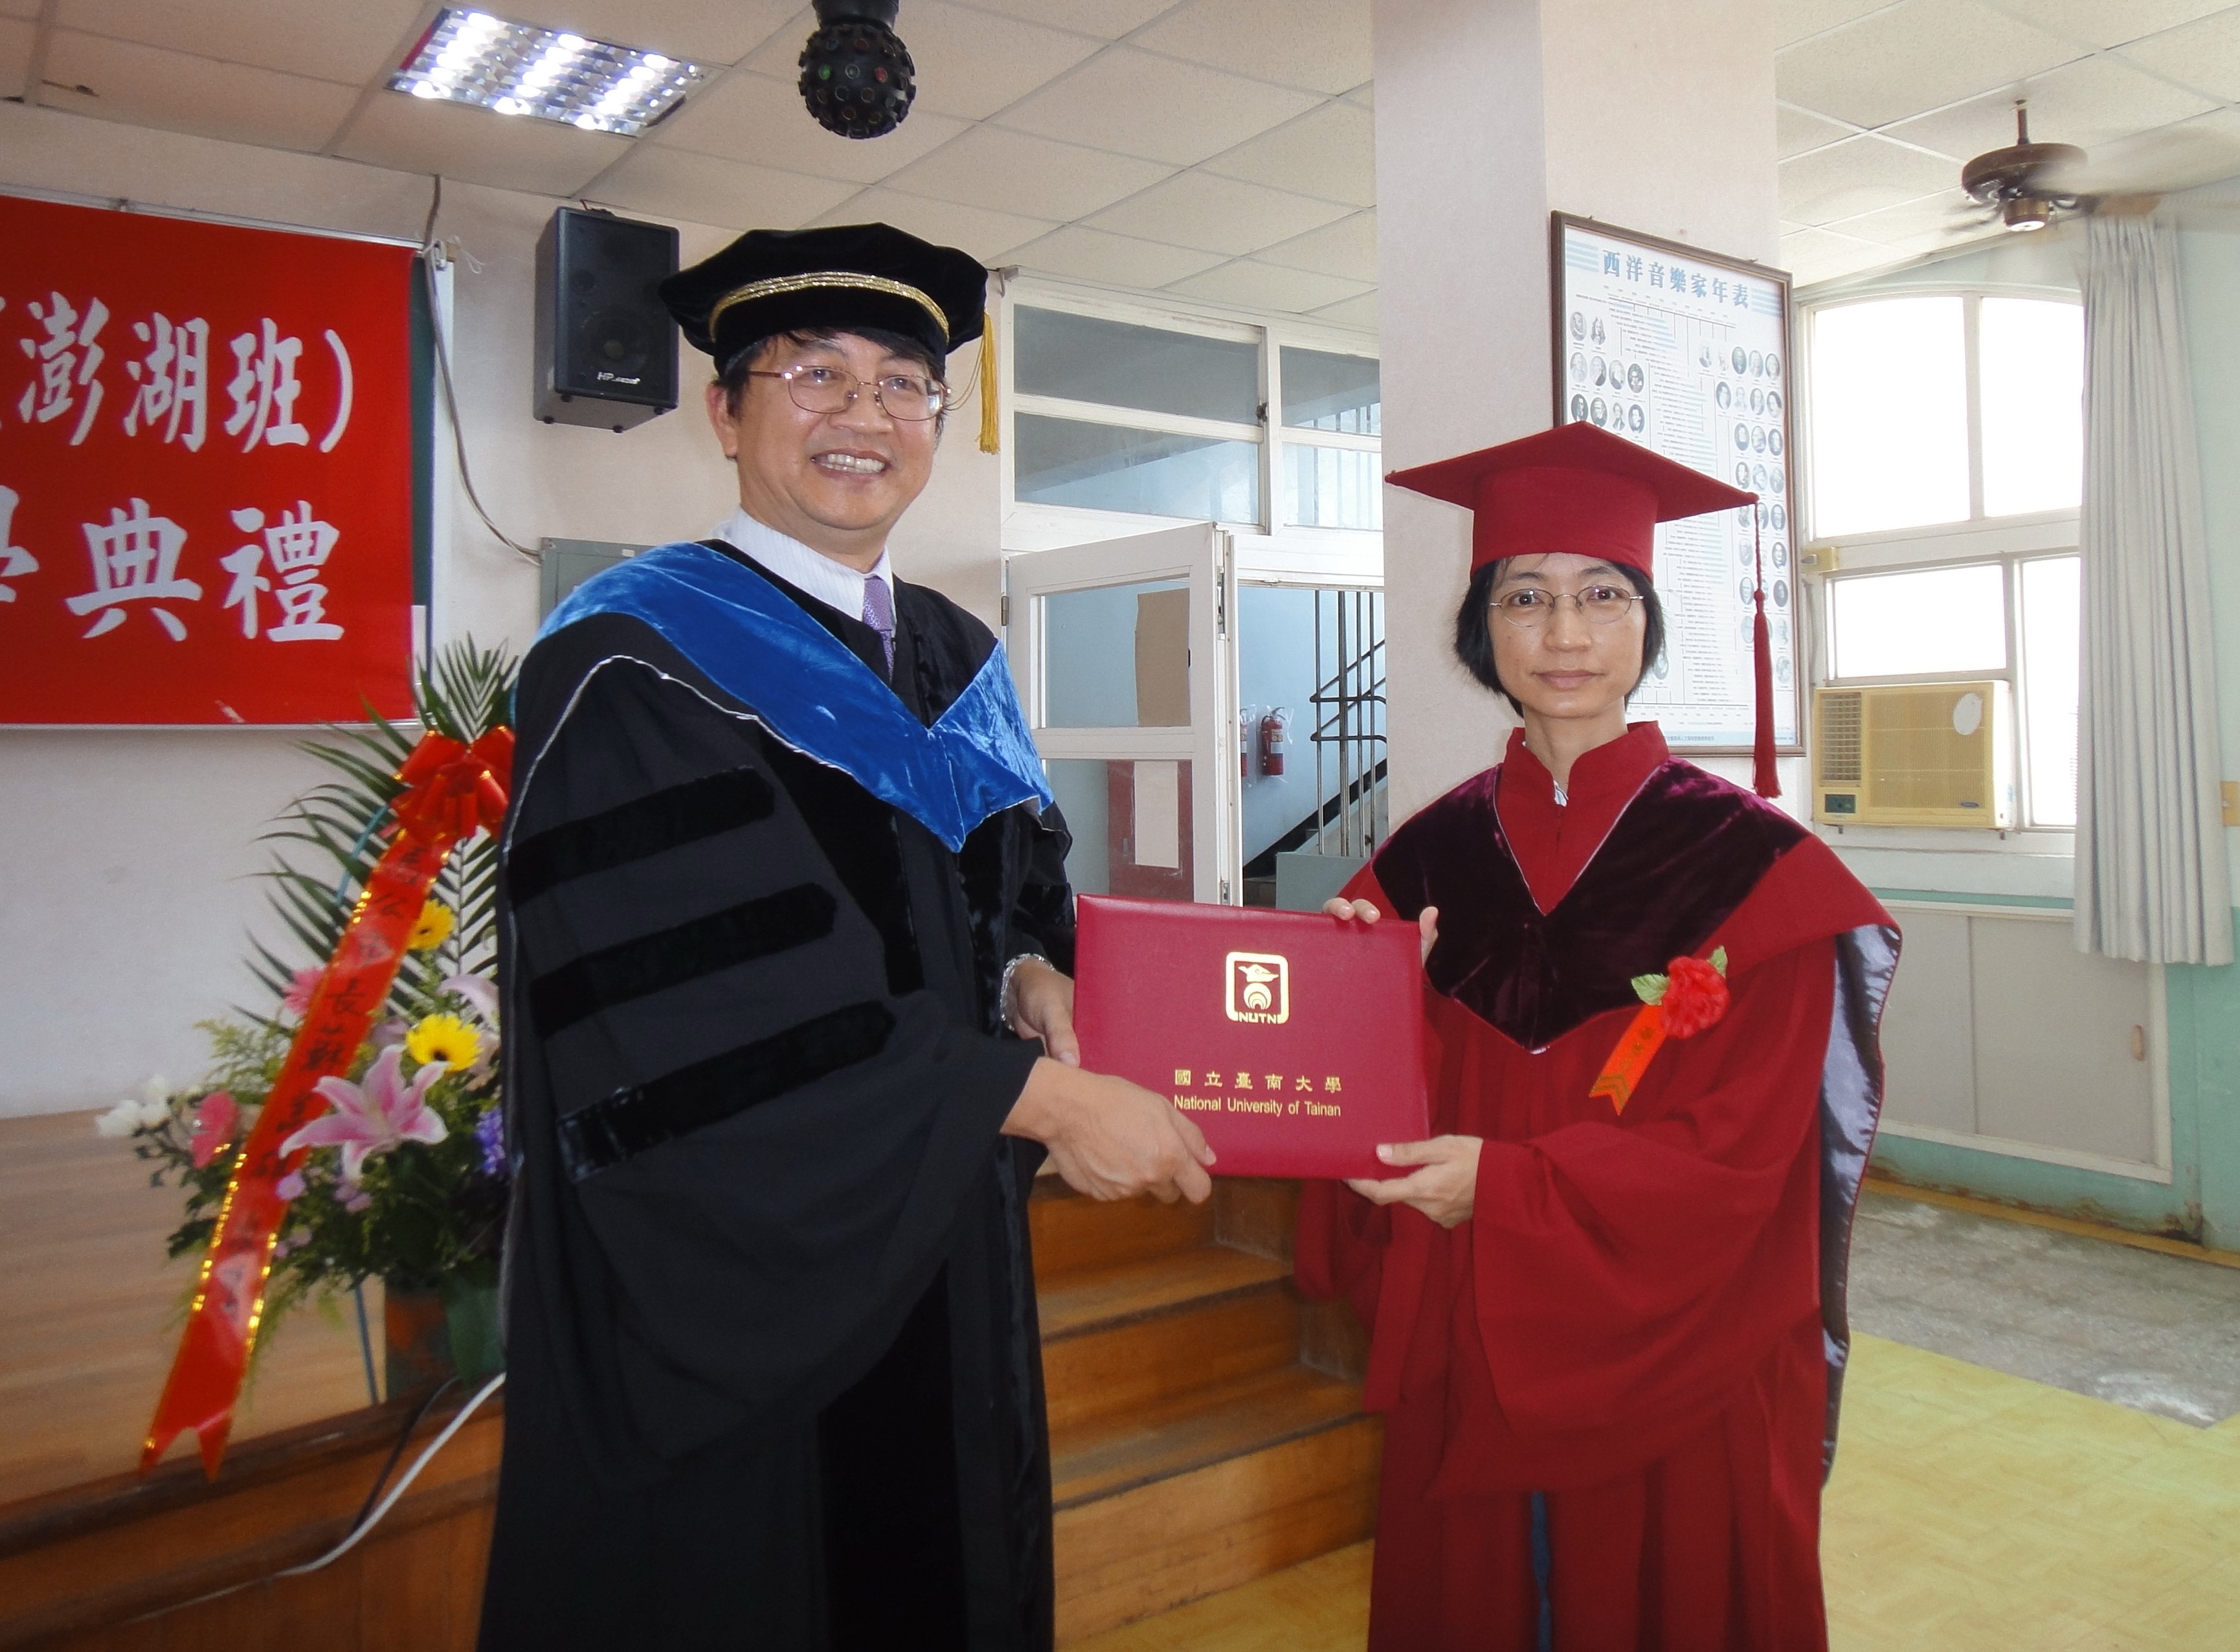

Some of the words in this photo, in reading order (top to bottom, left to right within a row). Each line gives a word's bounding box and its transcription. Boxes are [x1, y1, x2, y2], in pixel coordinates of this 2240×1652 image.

[1603, 249, 1749, 309] 西洋音樂家年表
[0, 291, 353, 453] 澎湖班)
[1238, 1011, 1277, 1024] NUTN
[1175, 1069, 1342, 1093] 國立臺南大學
[1174, 1094, 1221, 1111] National
[1227, 1097, 1282, 1117] University
[1288, 1100, 1300, 1115] of
[1304, 1101, 1341, 1117] Tainan
